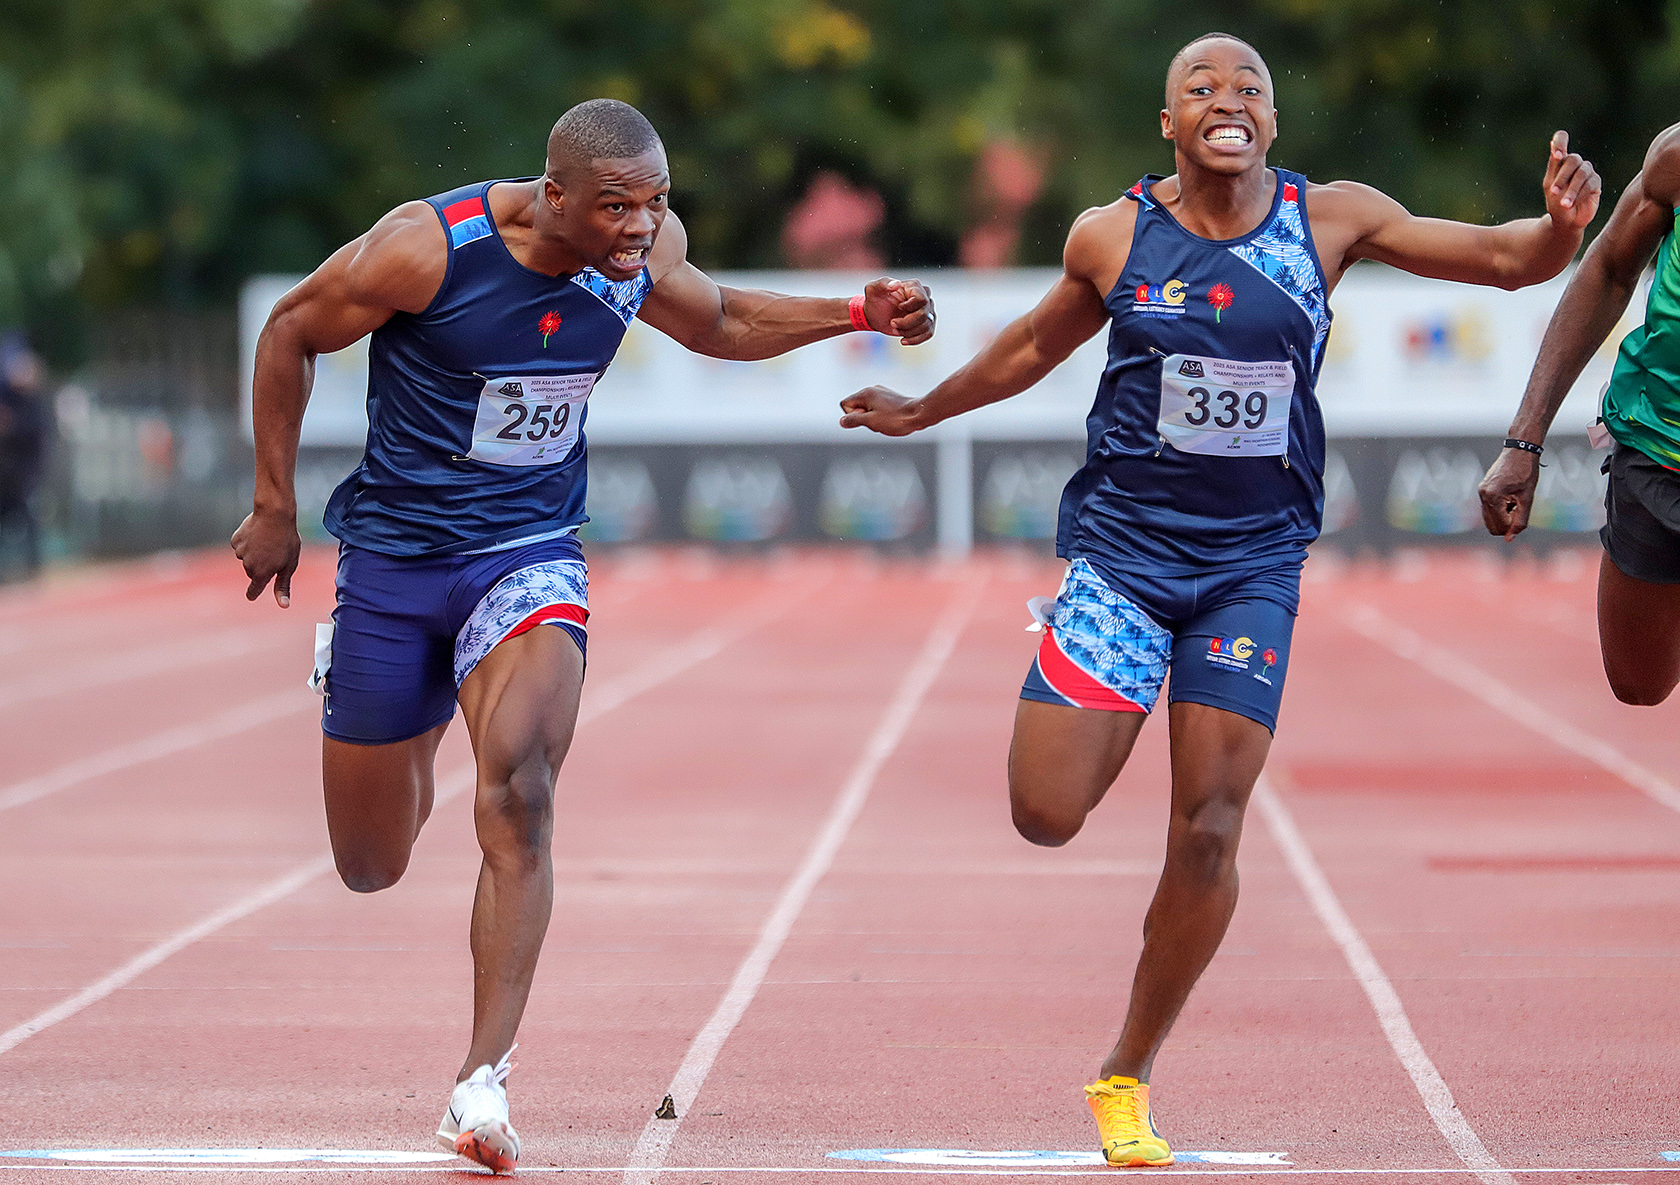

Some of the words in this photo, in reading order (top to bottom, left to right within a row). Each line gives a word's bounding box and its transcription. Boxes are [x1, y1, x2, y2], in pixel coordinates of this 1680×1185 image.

[1182, 361, 1202, 371] ASA
[1213, 370, 1254, 378] CHAMPIONSHIPS
[504, 384, 522, 392] ASA
[1184, 386, 1268, 430] 339
[496, 402, 570, 442] 259
